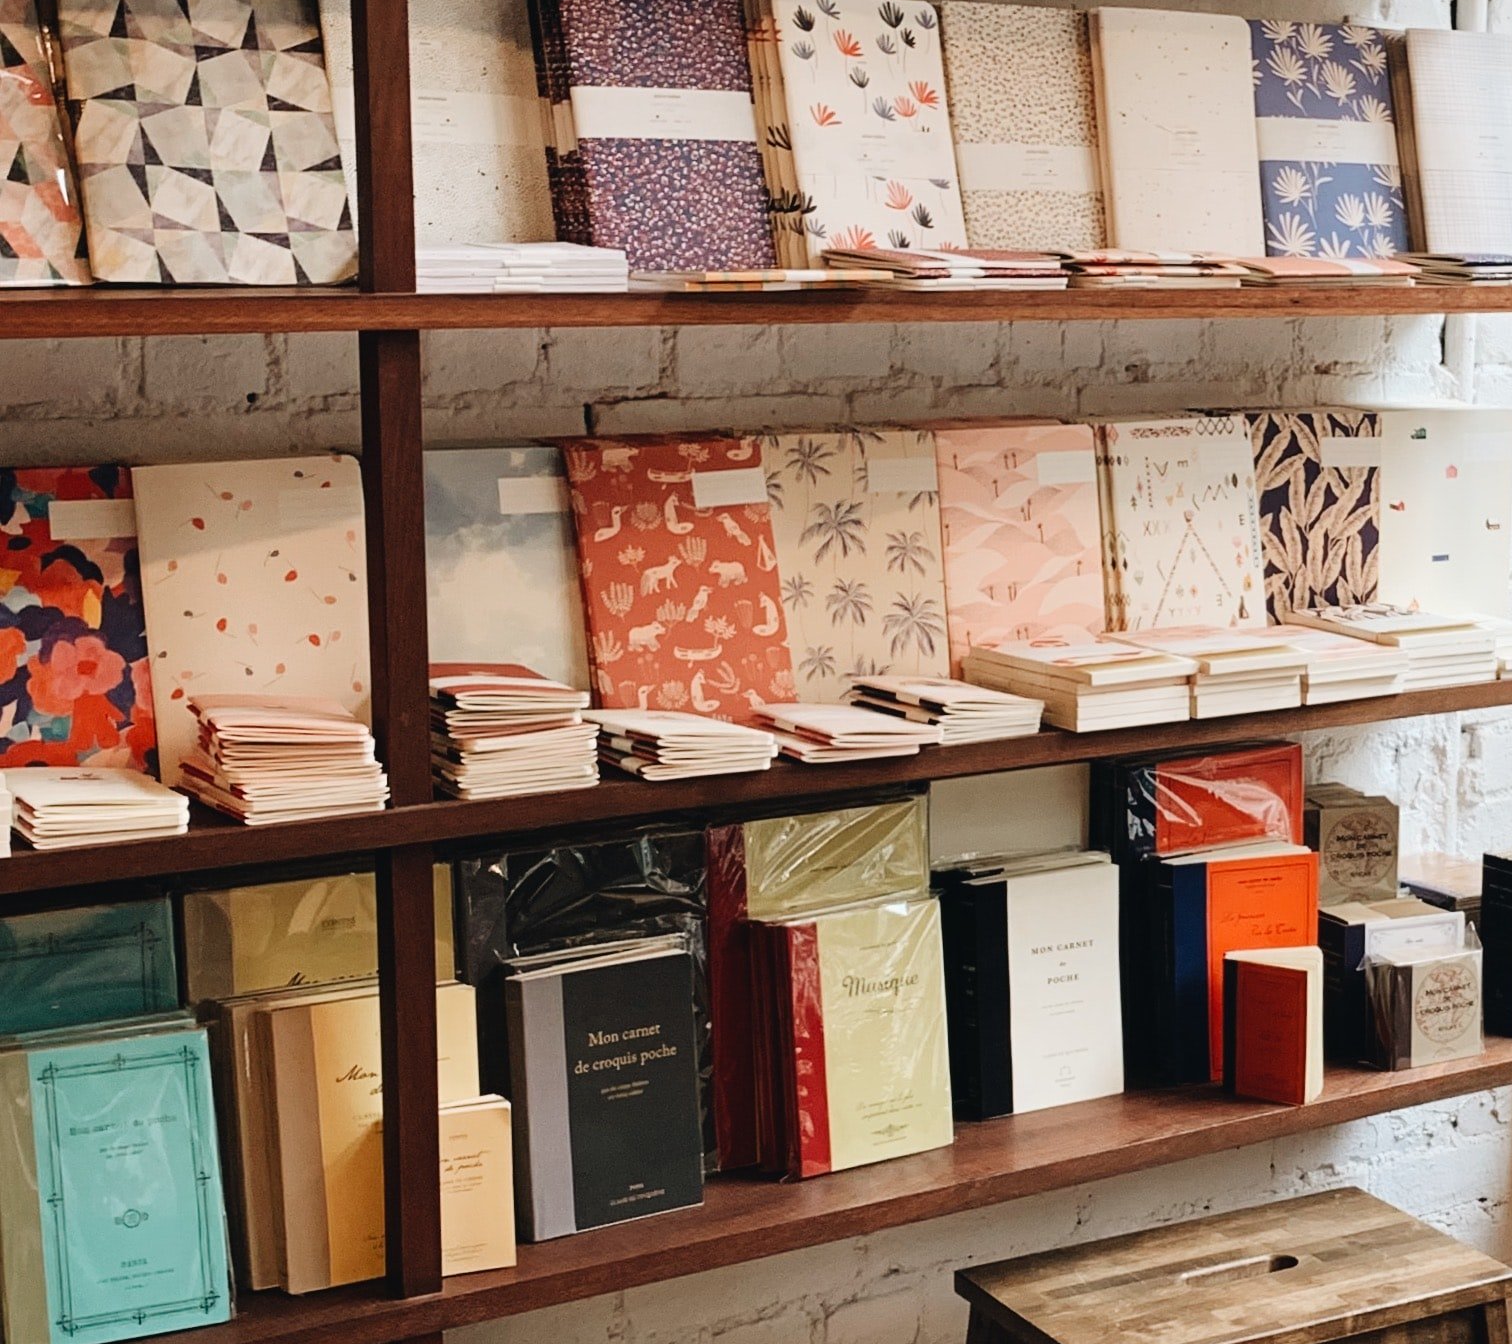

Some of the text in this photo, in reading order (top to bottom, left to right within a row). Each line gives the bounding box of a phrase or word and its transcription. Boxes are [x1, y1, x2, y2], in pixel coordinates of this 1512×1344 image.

[1031, 939, 1095, 956] MON CARNET
[1047, 972, 1080, 985] POCHE
[588, 1023, 661, 1047] Mon carnet
[574, 1043, 678, 1075] de croquis poche
